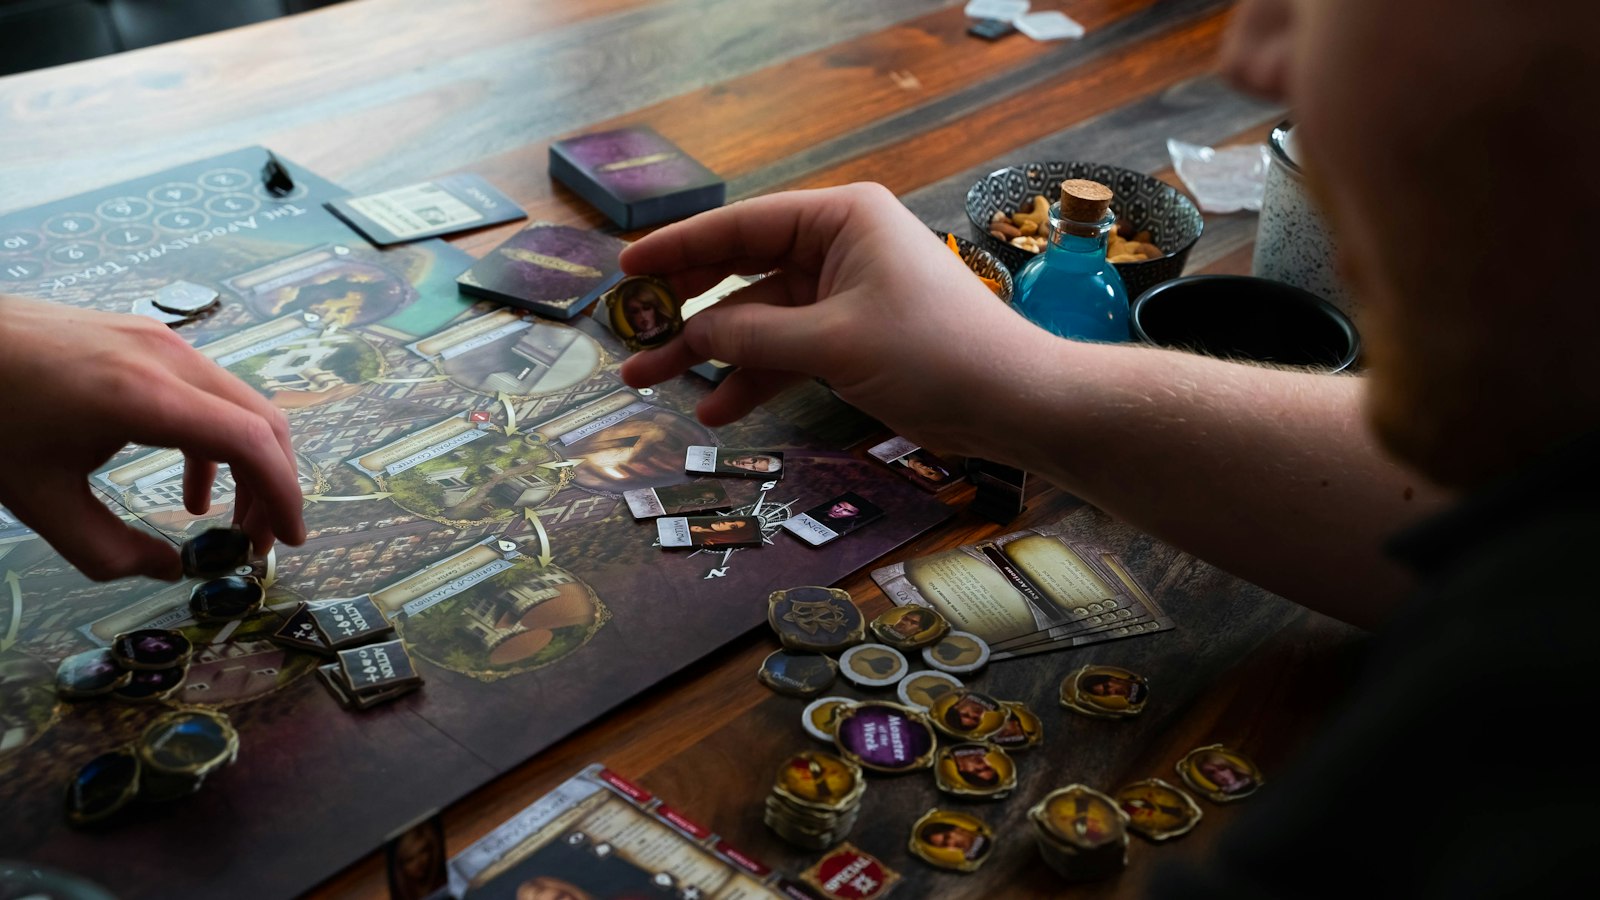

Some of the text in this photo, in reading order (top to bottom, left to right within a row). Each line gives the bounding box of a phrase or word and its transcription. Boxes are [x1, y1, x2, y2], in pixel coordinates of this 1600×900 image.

[40, 204, 307, 291] THE APOCALYPSE TRACK
[701, 449, 711, 468] SPIKE
[760, 480, 777, 492] S
[673, 519, 685, 547] WILLOW
[800, 516, 830, 538] ANGEL
[704, 566, 730, 580] N
[1004, 565, 1039, 599] Evil Actions
[342, 603, 371, 632] ACTION
[372, 647, 396, 678] ACTION
[771, 671, 804, 687] Demon
[863, 721, 878, 751] Week
[879, 733, 887, 746] the
[887, 714, 904, 761] Monster
[824, 855, 871, 893] SPECIAL
